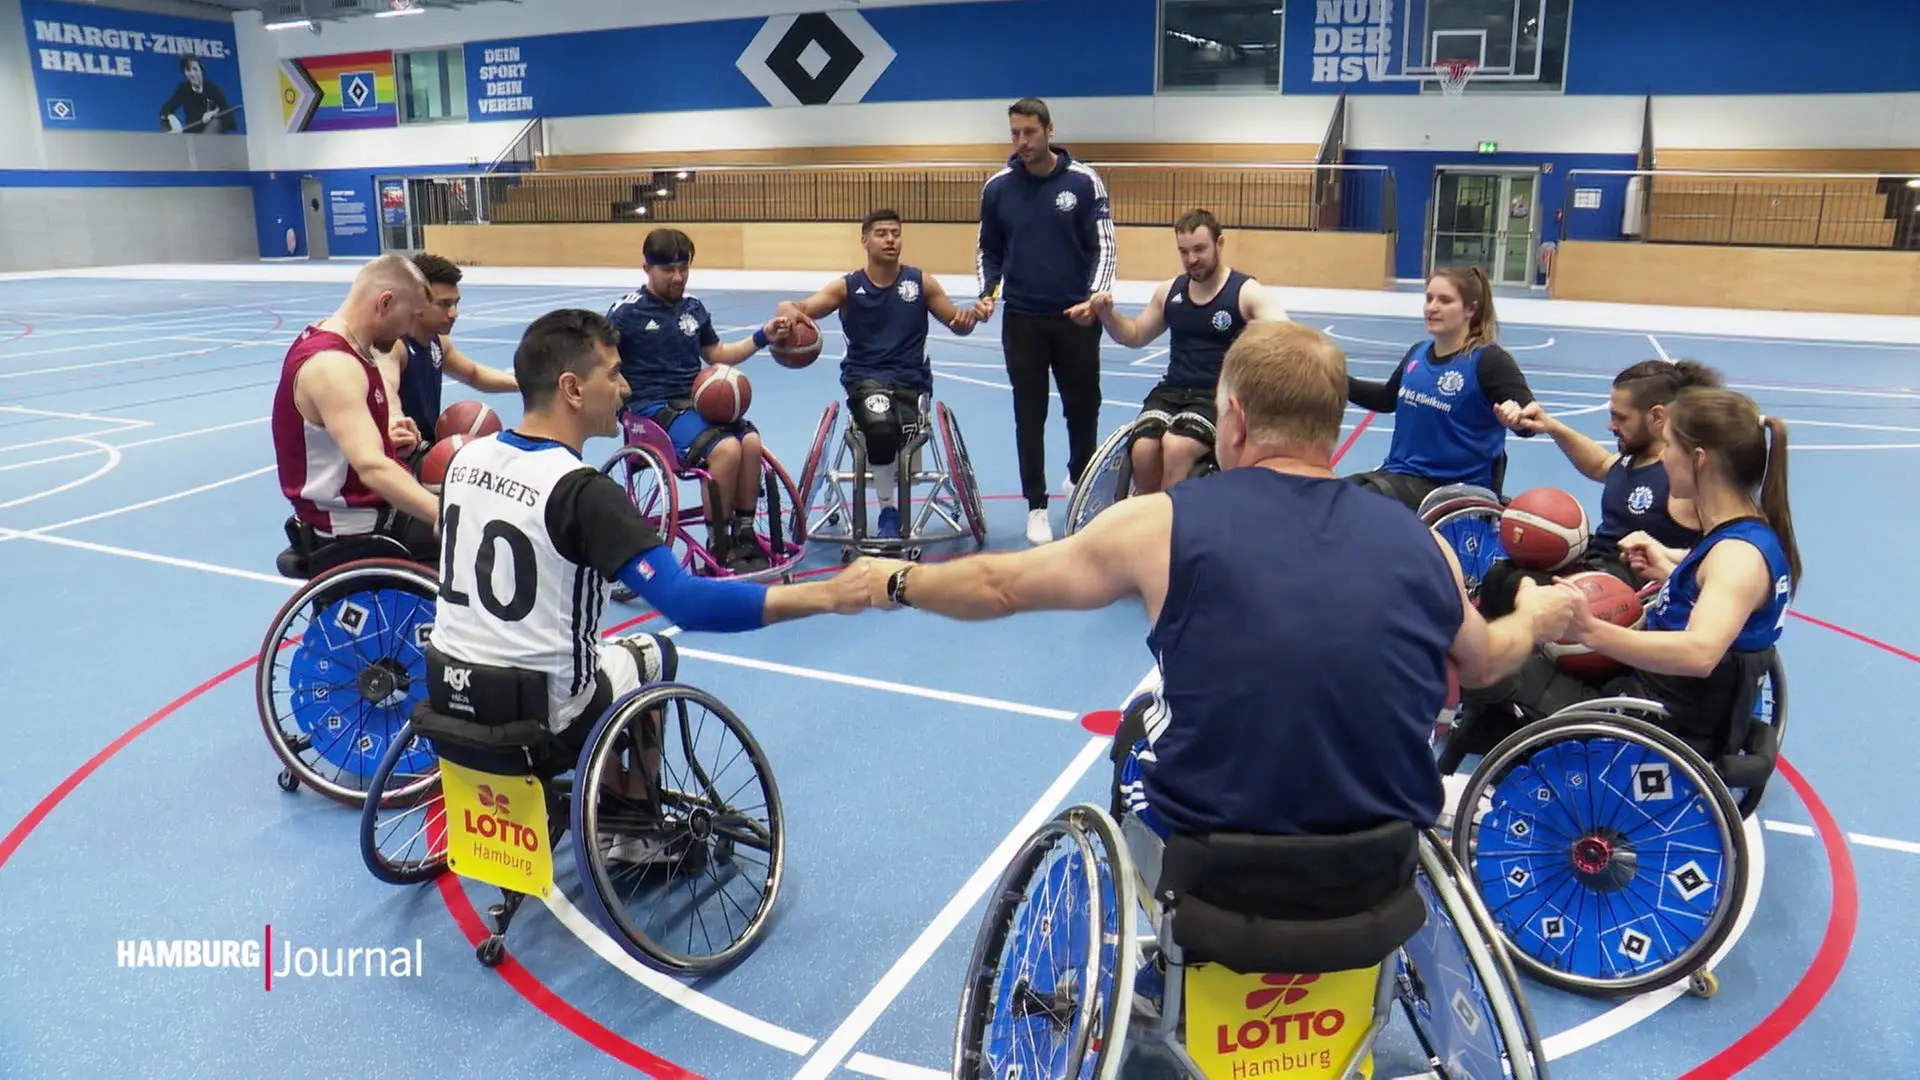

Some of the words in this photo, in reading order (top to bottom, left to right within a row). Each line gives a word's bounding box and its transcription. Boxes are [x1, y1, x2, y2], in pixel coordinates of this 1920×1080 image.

[1314, 0, 1394, 24] NUR
[33, 19, 231, 60] MARGIT-ZINKE-
[1313, 26, 1392, 54] DER
[39, 49, 133, 77] HALLE
[484, 46, 521, 64] DEIN
[1311, 56, 1391, 82] HSV
[479, 63, 528, 80] SPORT
[487, 80, 522, 98] DEIN
[478, 96, 534, 114] VEREIN
[467, 467, 540, 508] BAKETS
[438, 502, 538, 622] 10
[464, 808, 539, 852] LOTTO
[473, 840, 532, 876] Hamburg
[1217, 1008, 1345, 1054] LOTTO
[1232, 1048, 1330, 1080] Hamburg
